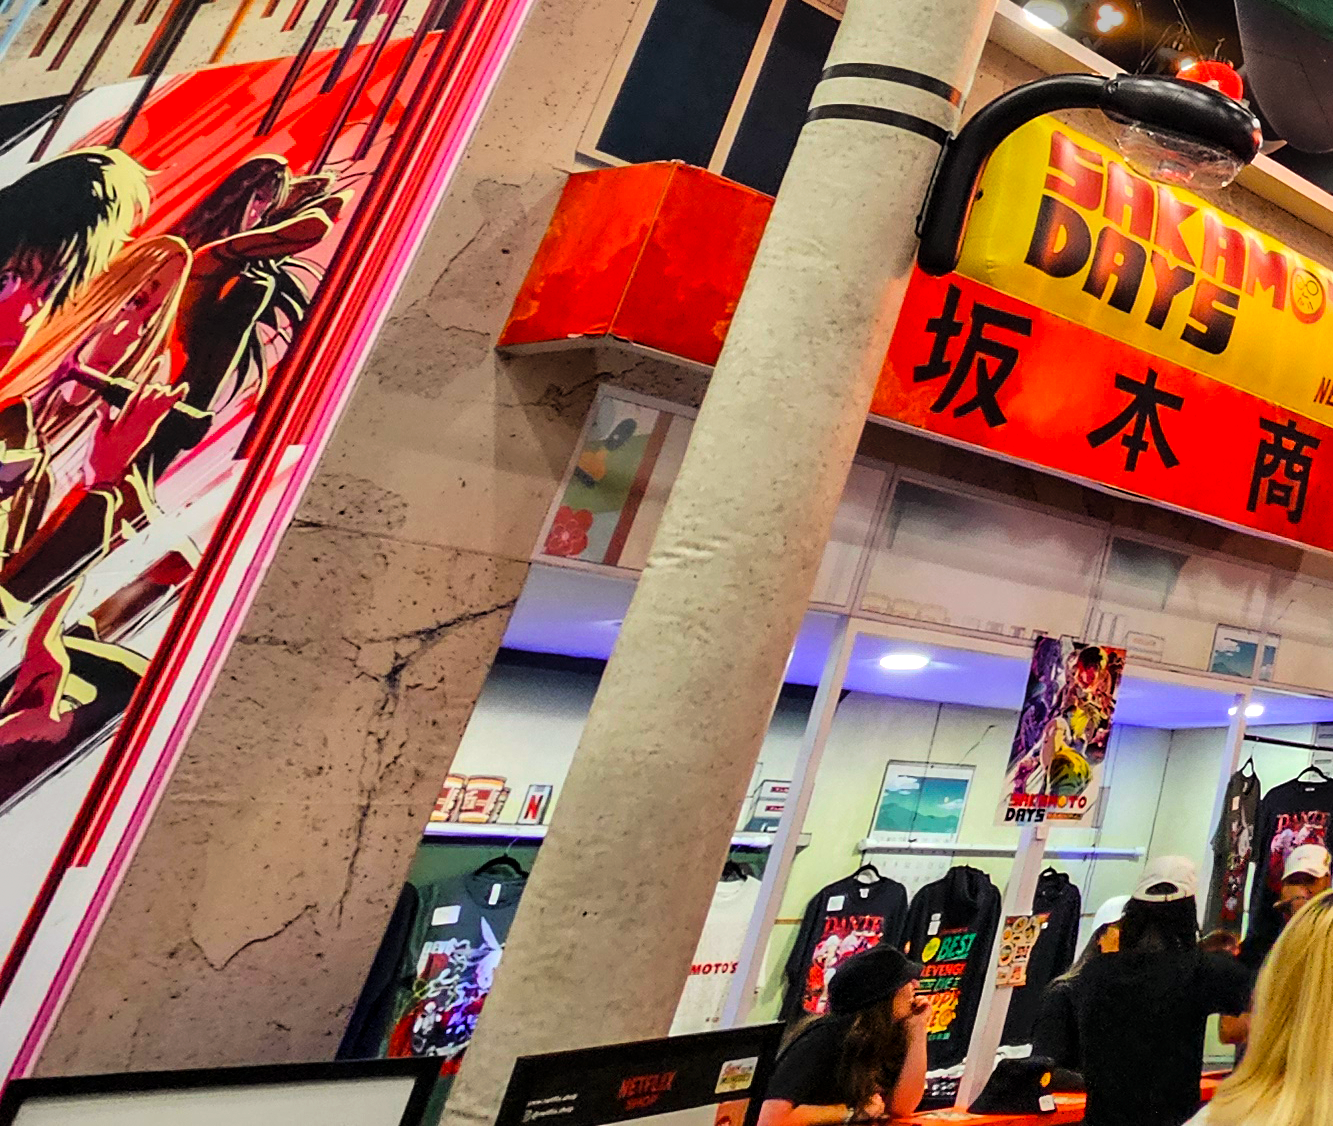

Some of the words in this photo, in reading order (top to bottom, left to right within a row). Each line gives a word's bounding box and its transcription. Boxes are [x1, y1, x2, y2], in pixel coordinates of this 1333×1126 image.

[1025, 194, 1243, 356] DAYS
[524, 795, 543, 819] N
[1004, 808, 1046, 822] DAYS
[690, 961, 738, 975] MOTO'S
